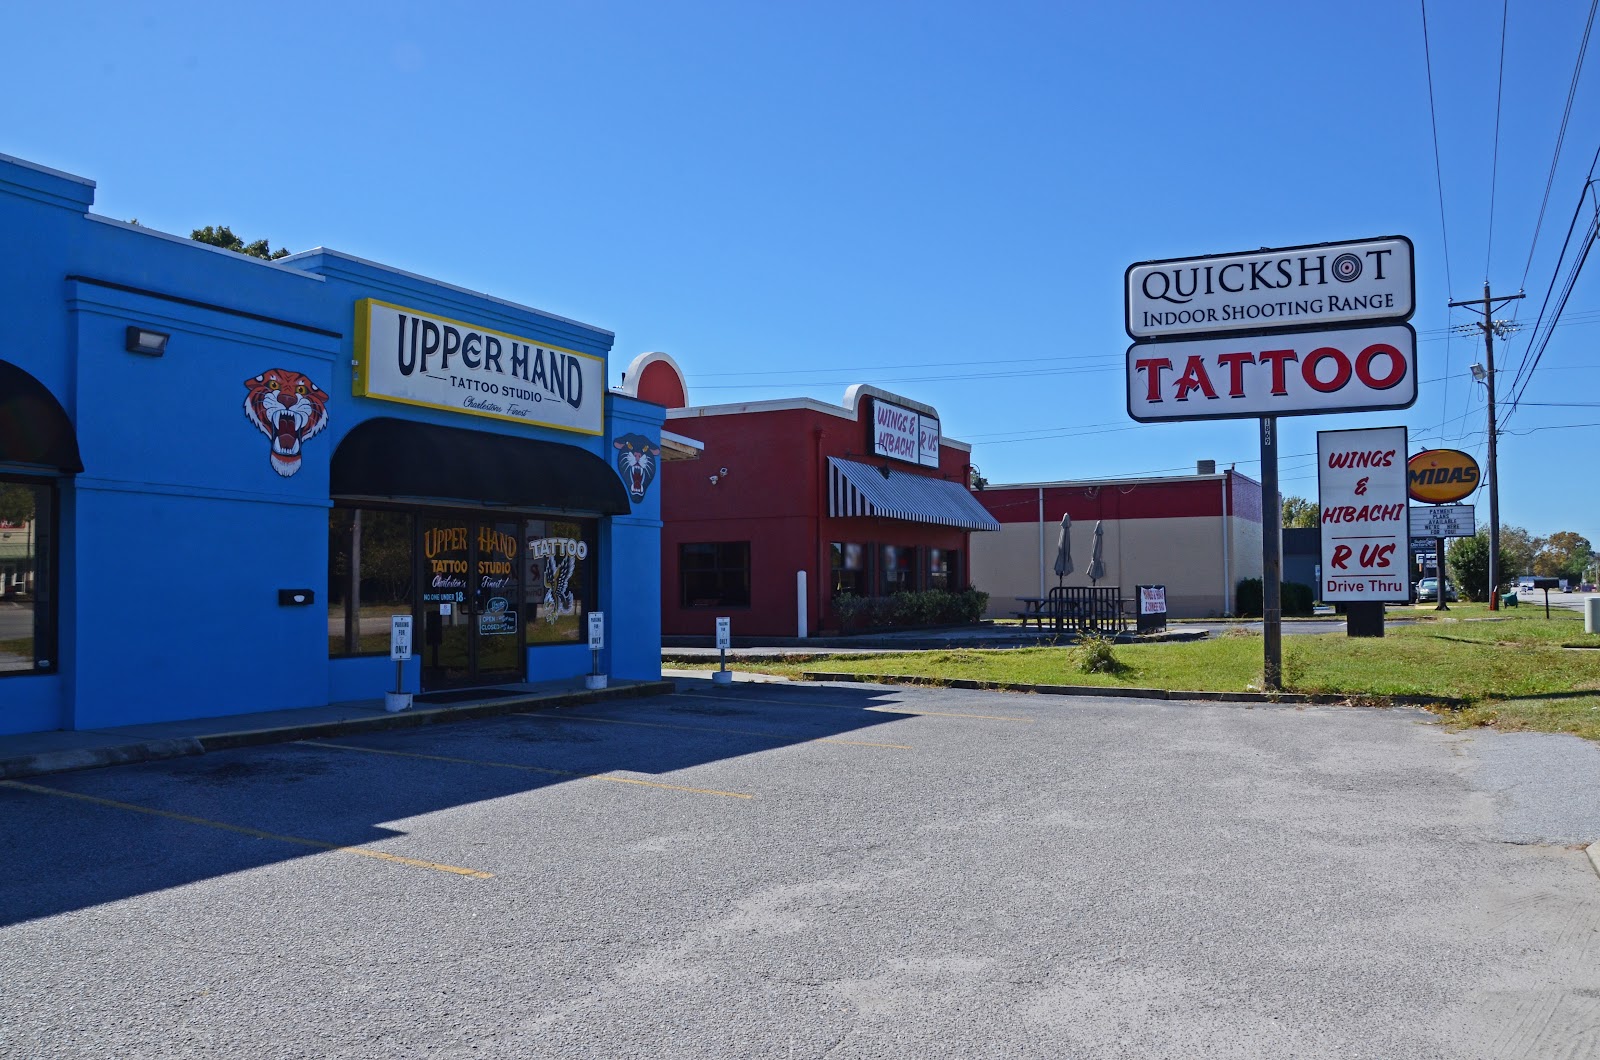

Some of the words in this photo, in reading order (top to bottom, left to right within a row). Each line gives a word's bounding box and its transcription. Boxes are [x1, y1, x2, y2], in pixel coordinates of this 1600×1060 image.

[1142, 249, 1392, 304] QUICKSHOT
[1143, 308, 1218, 327] INDOOR
[1222, 299, 1323, 321] SHOOTING
[1327, 293, 1394, 312] RANGE
[398, 313, 503, 377] UPPER
[510, 342, 583, 411] HAND
[1135, 343, 1408, 404] TATTOO
[450, 375, 499, 394] TATTOO
[502, 386, 542, 403] STUDIO
[507, 403, 531, 416] Finest
[877, 406, 908, 432] WINGS
[909, 416, 915, 436] &
[878, 431, 915, 458] HIBACHI
[920, 430, 926, 450] R
[928, 433, 938, 452] US
[1328, 449, 1396, 469] WINGS
[1409, 461, 1478, 485] MIDAS
[1354, 476, 1369, 496] &
[1322, 503, 1405, 524] HIBACHI
[424, 527, 467, 558] UPPER
[477, 526, 517, 561] HAND
[529, 537, 588, 561] TATTOO
[431, 559, 468, 574] TATTOO
[478, 561, 511, 574] STUDIO
[1331, 544, 1352, 569] R
[1359, 543, 1396, 568] US
[440, 593, 454, 601] UNDER
[1327, 580, 1364, 592] Drive
[1369, 579, 1402, 592] Thru
[395, 646, 408, 654] ONLY
